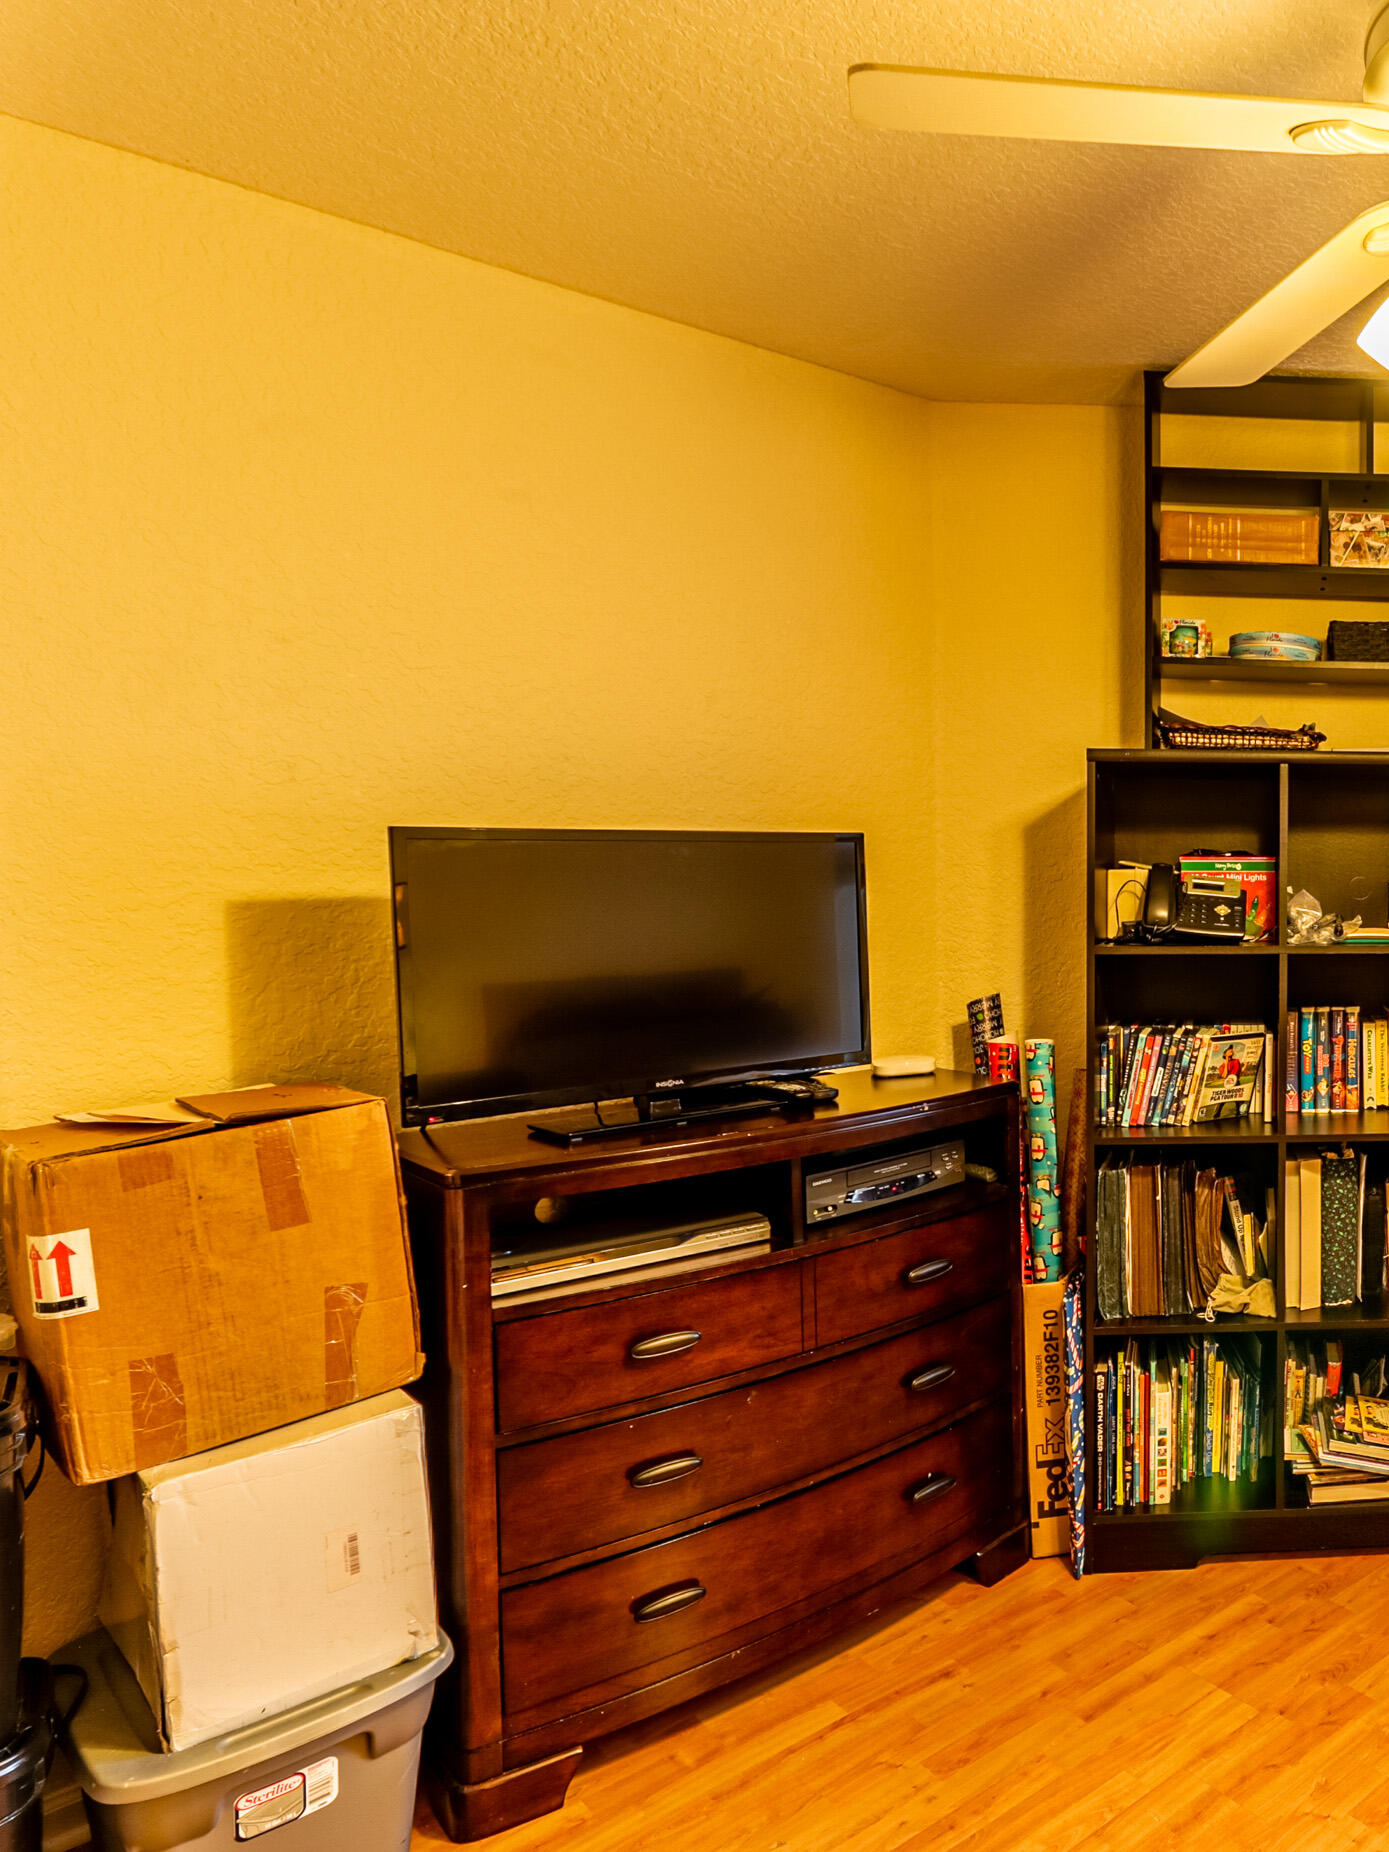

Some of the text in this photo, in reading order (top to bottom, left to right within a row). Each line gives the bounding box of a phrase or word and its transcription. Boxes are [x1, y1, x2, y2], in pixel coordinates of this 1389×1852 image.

[1244, 874, 1267, 882] Lights
[1043, 1309, 1061, 1406] 139382F10
[1096, 1423, 1104, 1452] VADER
[1036, 1418, 1068, 1519] FedEx
[243, 1780, 298, 1808] Sterilite
